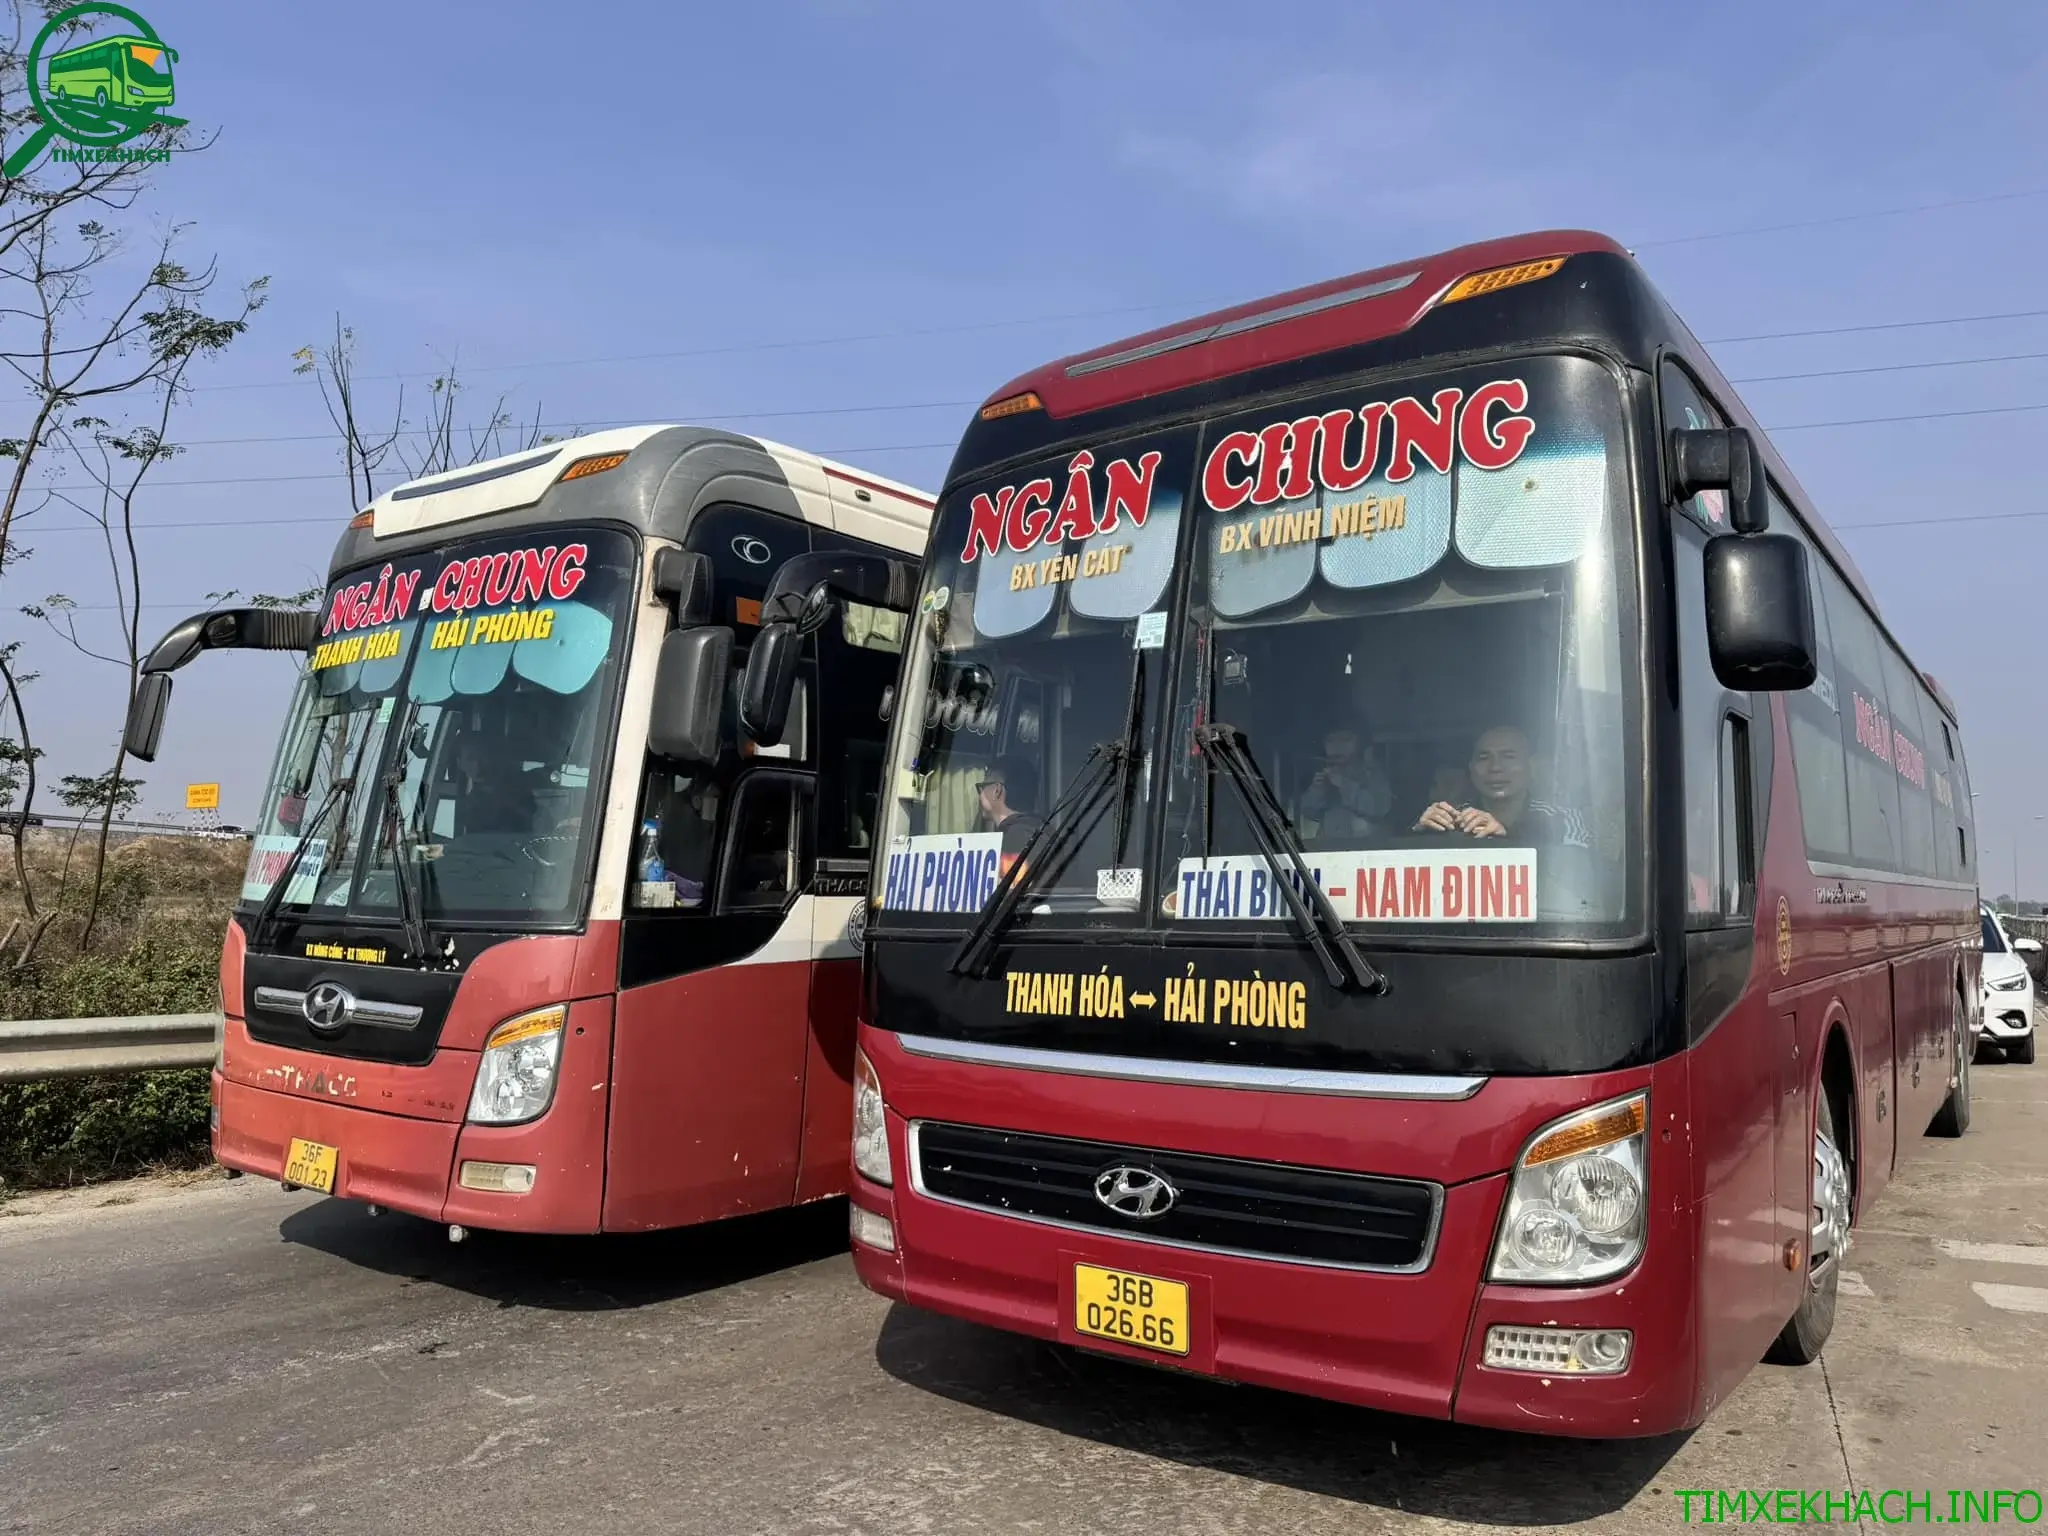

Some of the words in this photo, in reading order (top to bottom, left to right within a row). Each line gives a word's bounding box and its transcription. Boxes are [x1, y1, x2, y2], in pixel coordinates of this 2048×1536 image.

[960, 450, 1162, 564] NGÂN
[1202, 379, 1535, 512] CHUNG
[1219, 522, 1252, 554] BX
[1259, 506, 1322, 548] VĨNH
[1330, 495, 1407, 540] NIỆM
[322, 562, 421, 637] NGÂN
[431, 543, 588, 613] CHUNG
[1009, 562, 1037, 592] BX
[1040, 551, 1078, 585] YÊN
[1083, 541, 1125, 578] CÁT
[311, 636, 364, 671] THANH
[363, 625, 401, 660] HÓA
[431, 609, 470, 650] HẢI
[470, 604, 556, 644] PHÒNG
[884, 838, 920, 912] HẢI
[920, 837, 997, 913] PHÒNG
[1182, 861, 1243, 918] THÁI
[1355, 866, 1431, 918] NAM
[1442, 865, 1529, 924] ĐỊNH
[1006, 972, 1073, 1015] THANH
[1079, 965, 1125, 1018] HÓA
[1164, 962, 1206, 1023] HẢI
[1213, 970, 1306, 1029] PHÒNG
[288, 1161, 328, 1188] 001.23
[301, 1143, 324, 1164] 36F
[1106, 1274, 1154, 1308] 36B
[1087, 1302, 1175, 1346] 026.66
